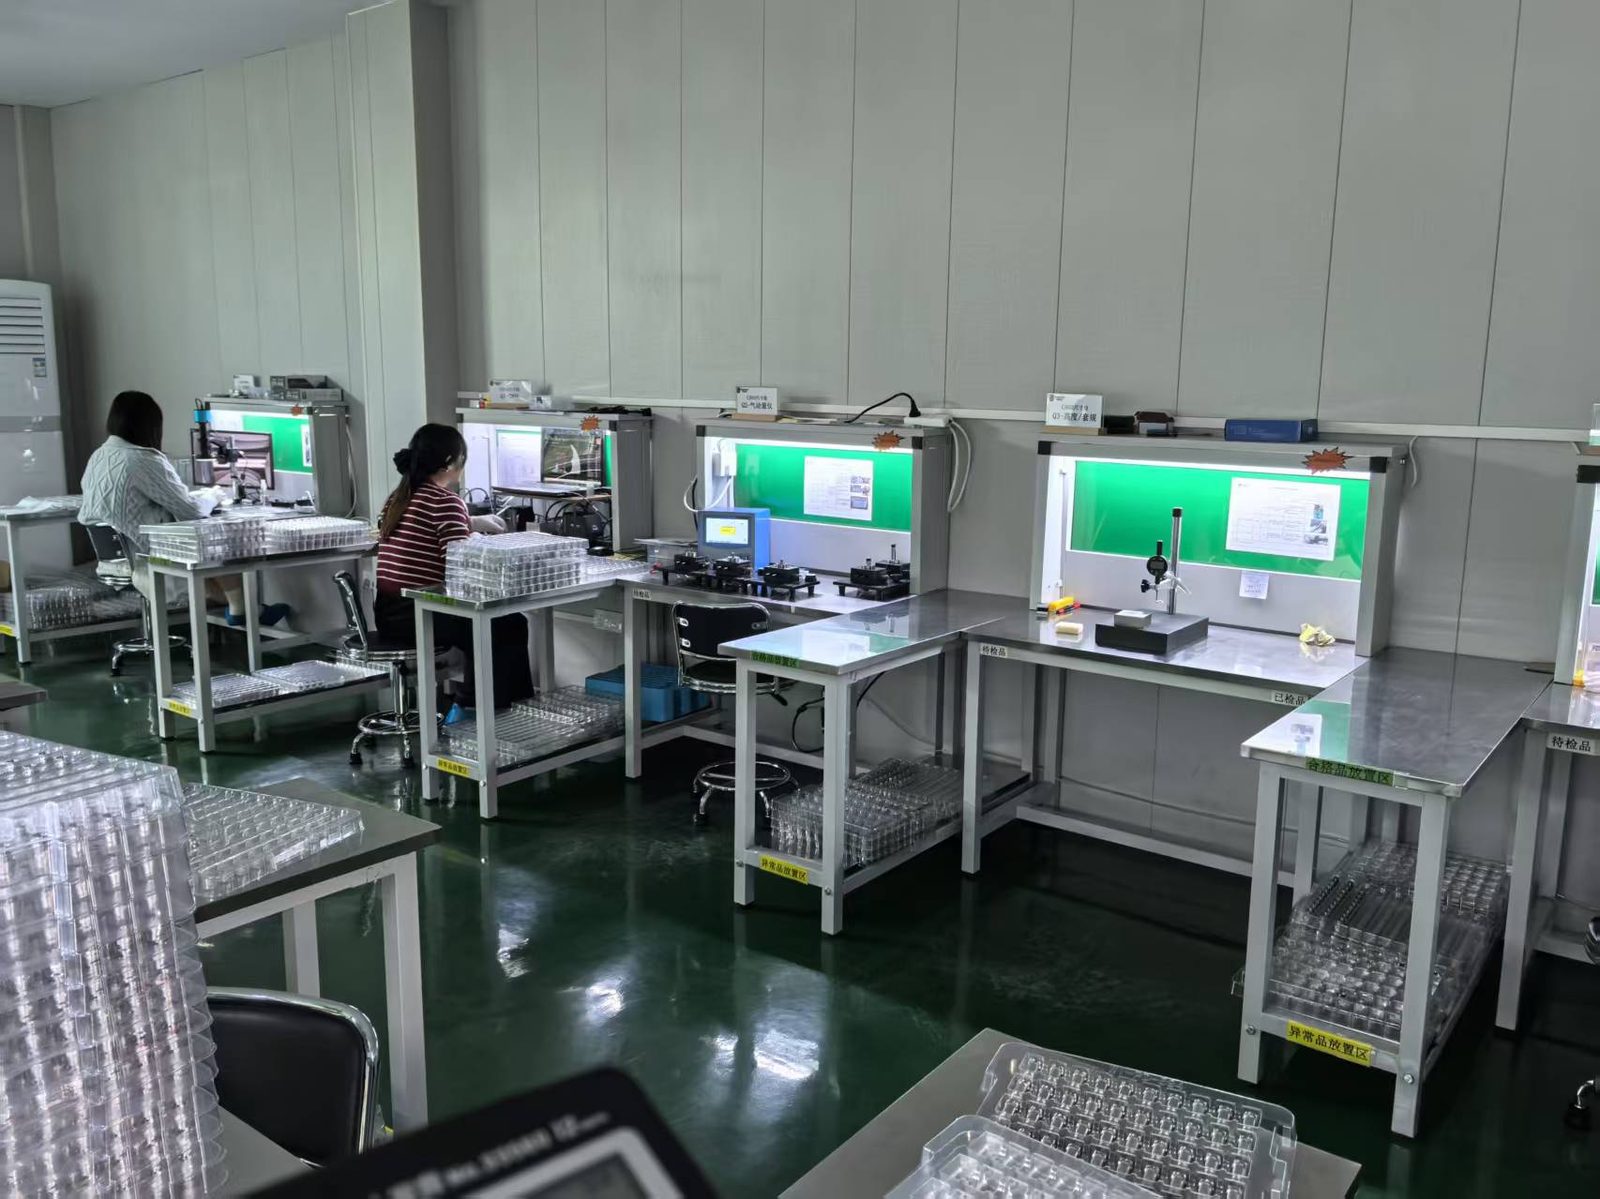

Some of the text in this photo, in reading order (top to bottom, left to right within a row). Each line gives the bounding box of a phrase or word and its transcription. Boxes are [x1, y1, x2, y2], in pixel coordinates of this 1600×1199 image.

[982, 644, 1006, 657] 待检品
[1274, 692, 1305, 705] 已检品
[1552, 735, 1591, 752] 待检品
[1289, 1024, 1369, 1061] 异常品放置区
